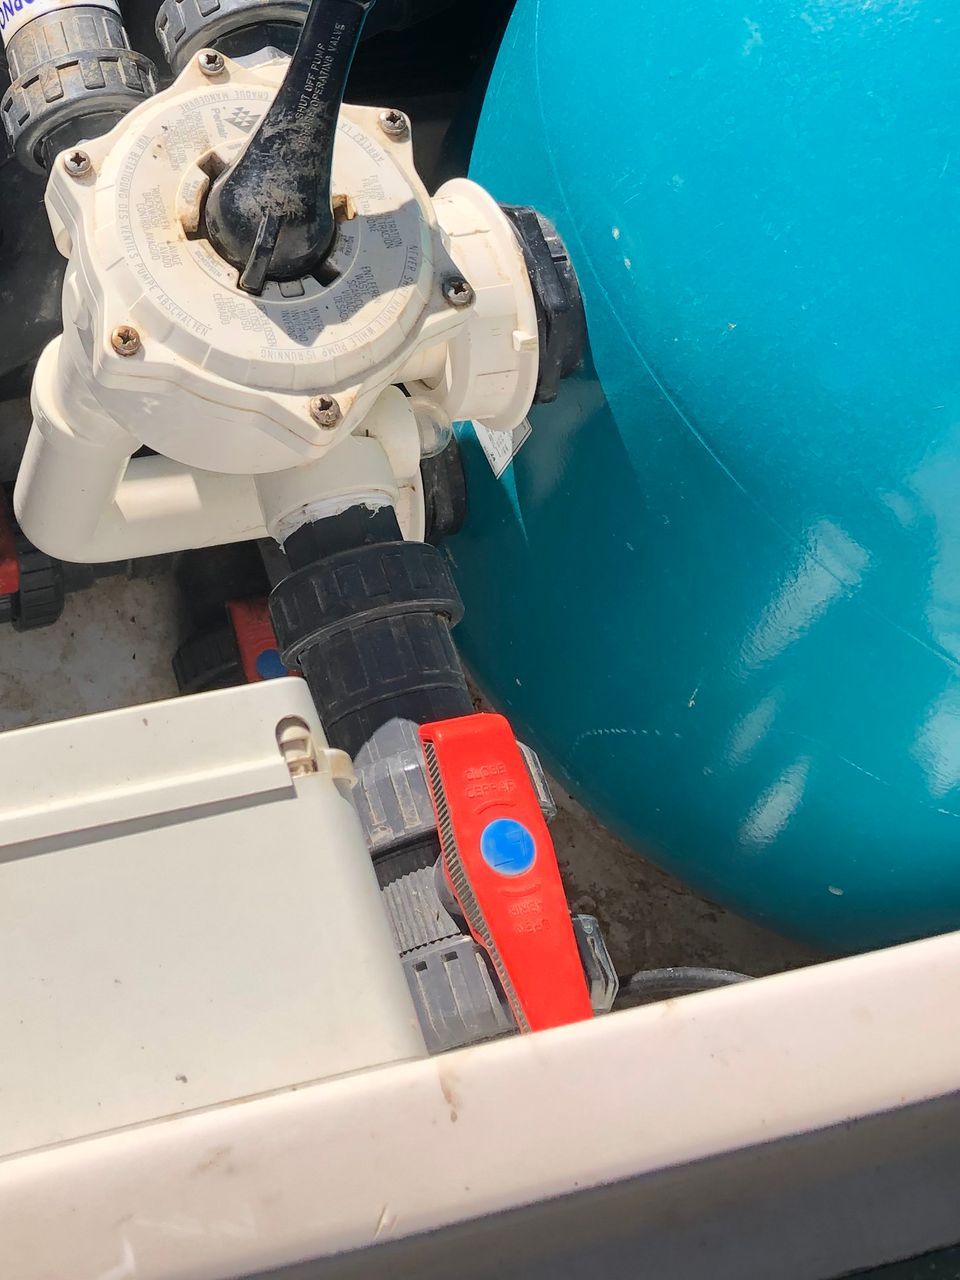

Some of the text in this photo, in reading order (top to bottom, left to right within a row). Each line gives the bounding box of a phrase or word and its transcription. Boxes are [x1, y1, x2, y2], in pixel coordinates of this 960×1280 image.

[295, 42, 326, 120] SHUT OFF PUMP
[309, 55, 335, 108] OPERATING
[327, 22, 345, 52] VALVE
[135, 263, 158, 292] PUMPE
[156, 294, 209, 337] ABSCHALTEN
